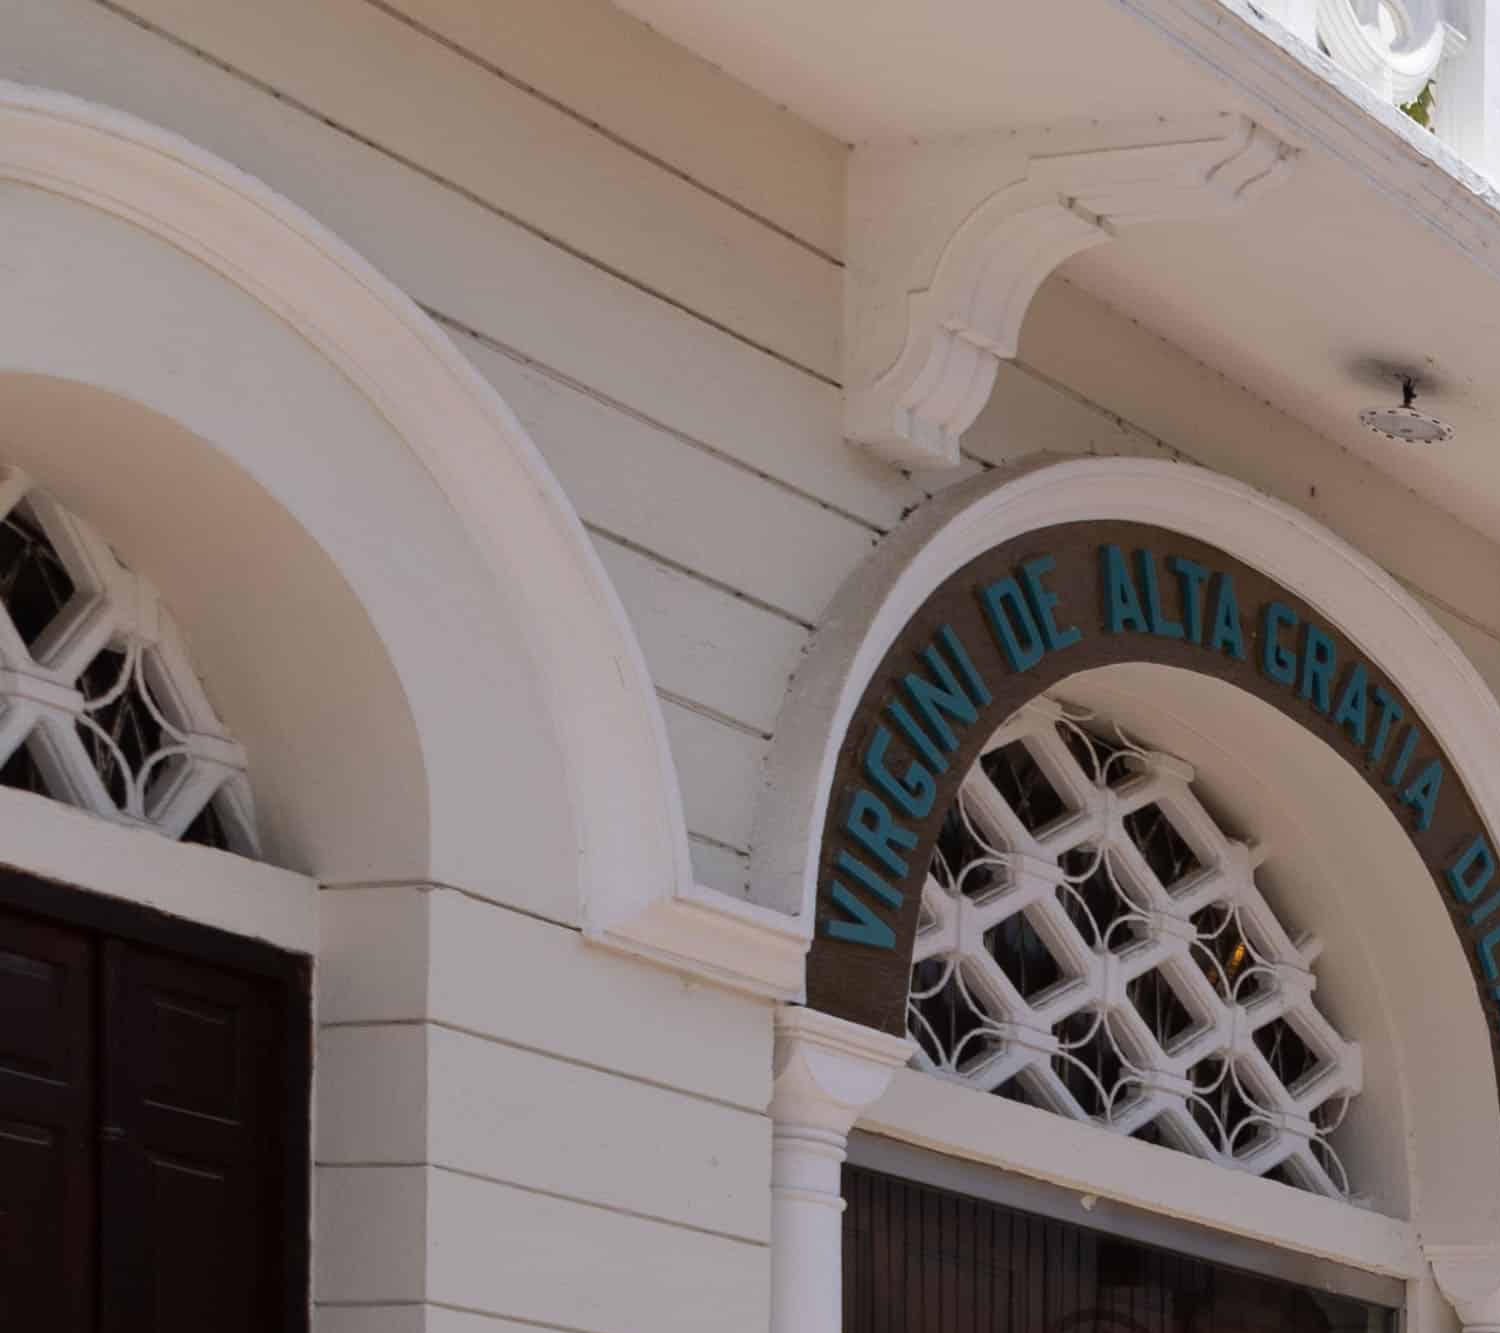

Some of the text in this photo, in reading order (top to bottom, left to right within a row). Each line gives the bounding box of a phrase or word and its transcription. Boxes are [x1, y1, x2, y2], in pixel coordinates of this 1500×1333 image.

[826, 623, 992, 949] VIRGINI
[980, 554, 1082, 672] DE
[1102, 544, 1246, 659] ALTA
[1260, 600, 1444, 831] GRATIA
